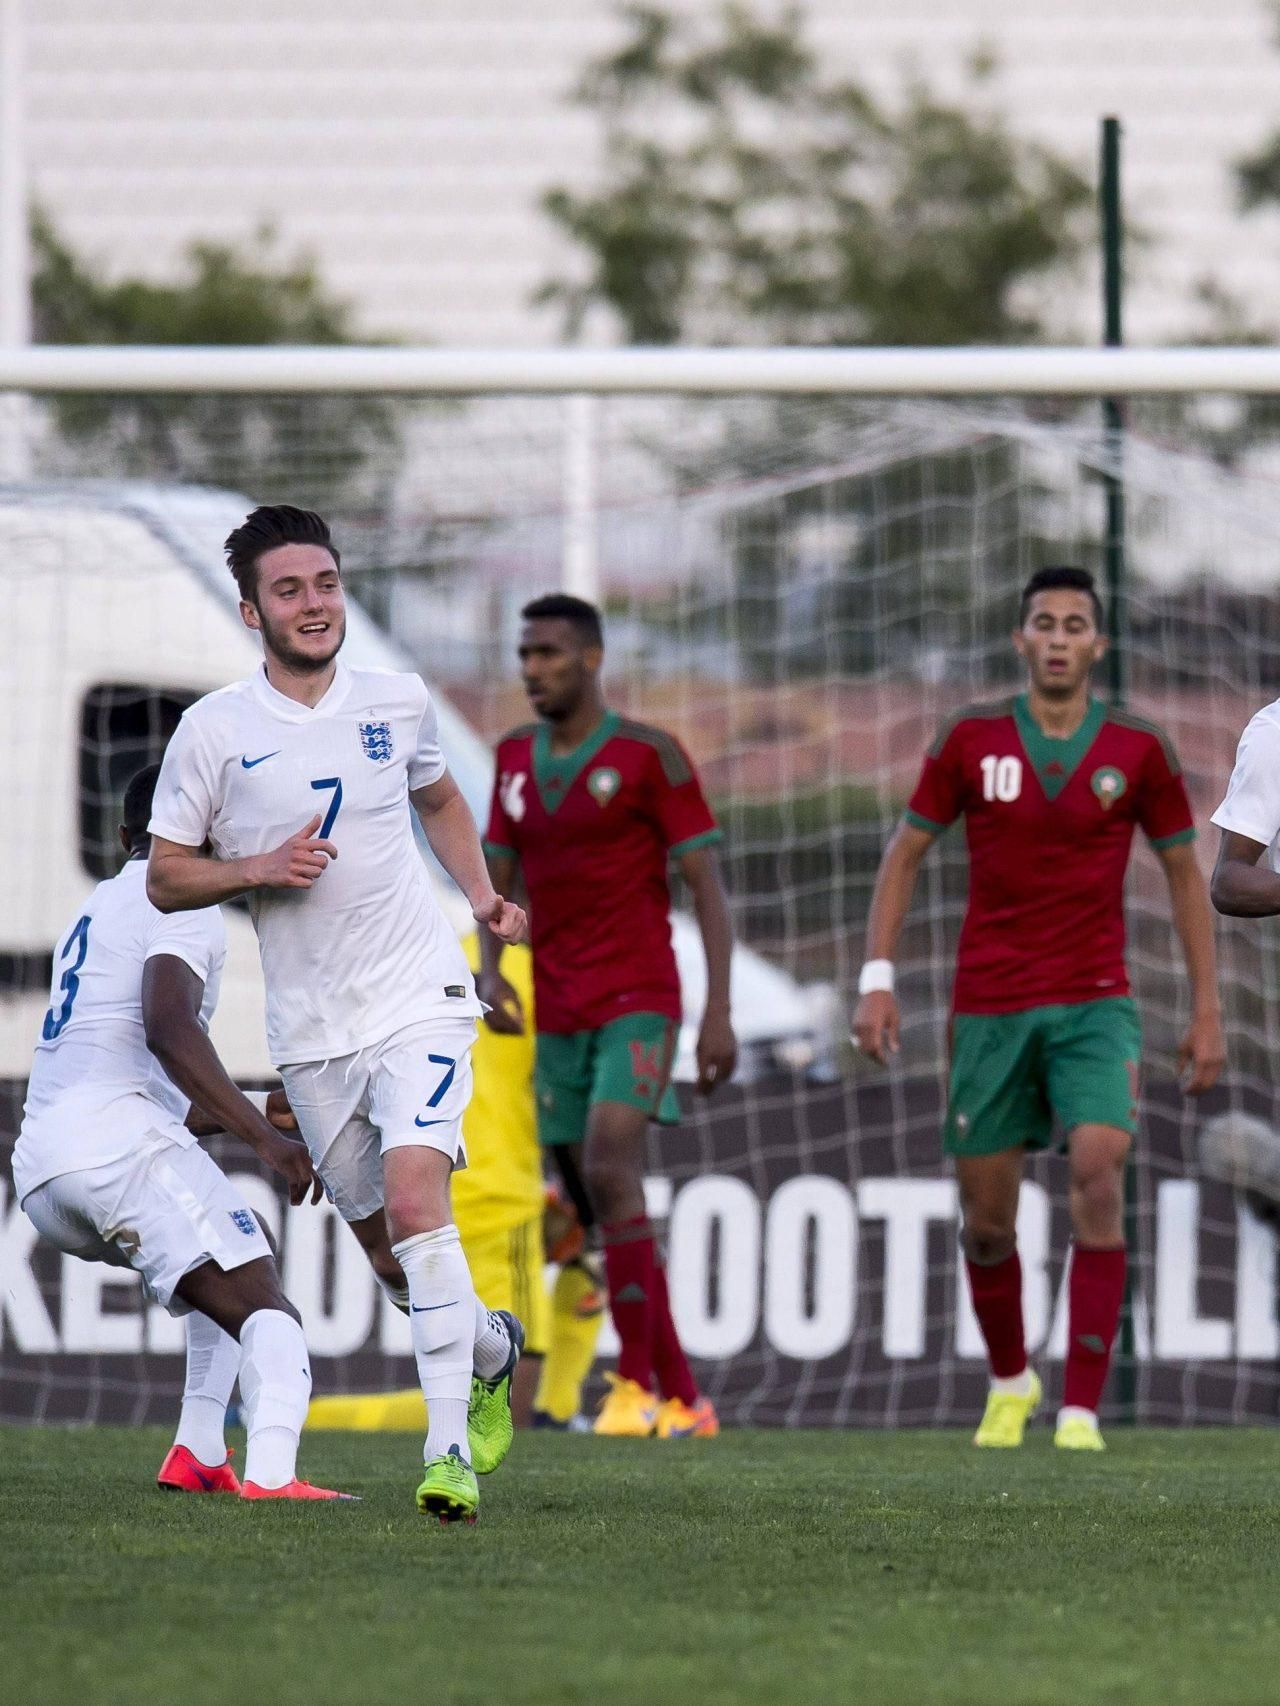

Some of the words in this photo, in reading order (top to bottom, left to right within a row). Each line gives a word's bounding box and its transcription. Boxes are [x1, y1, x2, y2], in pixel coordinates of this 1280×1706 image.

[980, 754, 1022, 802] 10
[310, 777, 343, 840] 7
[42, 915, 93, 1041] 3
[426, 1053, 457, 1108] 7
